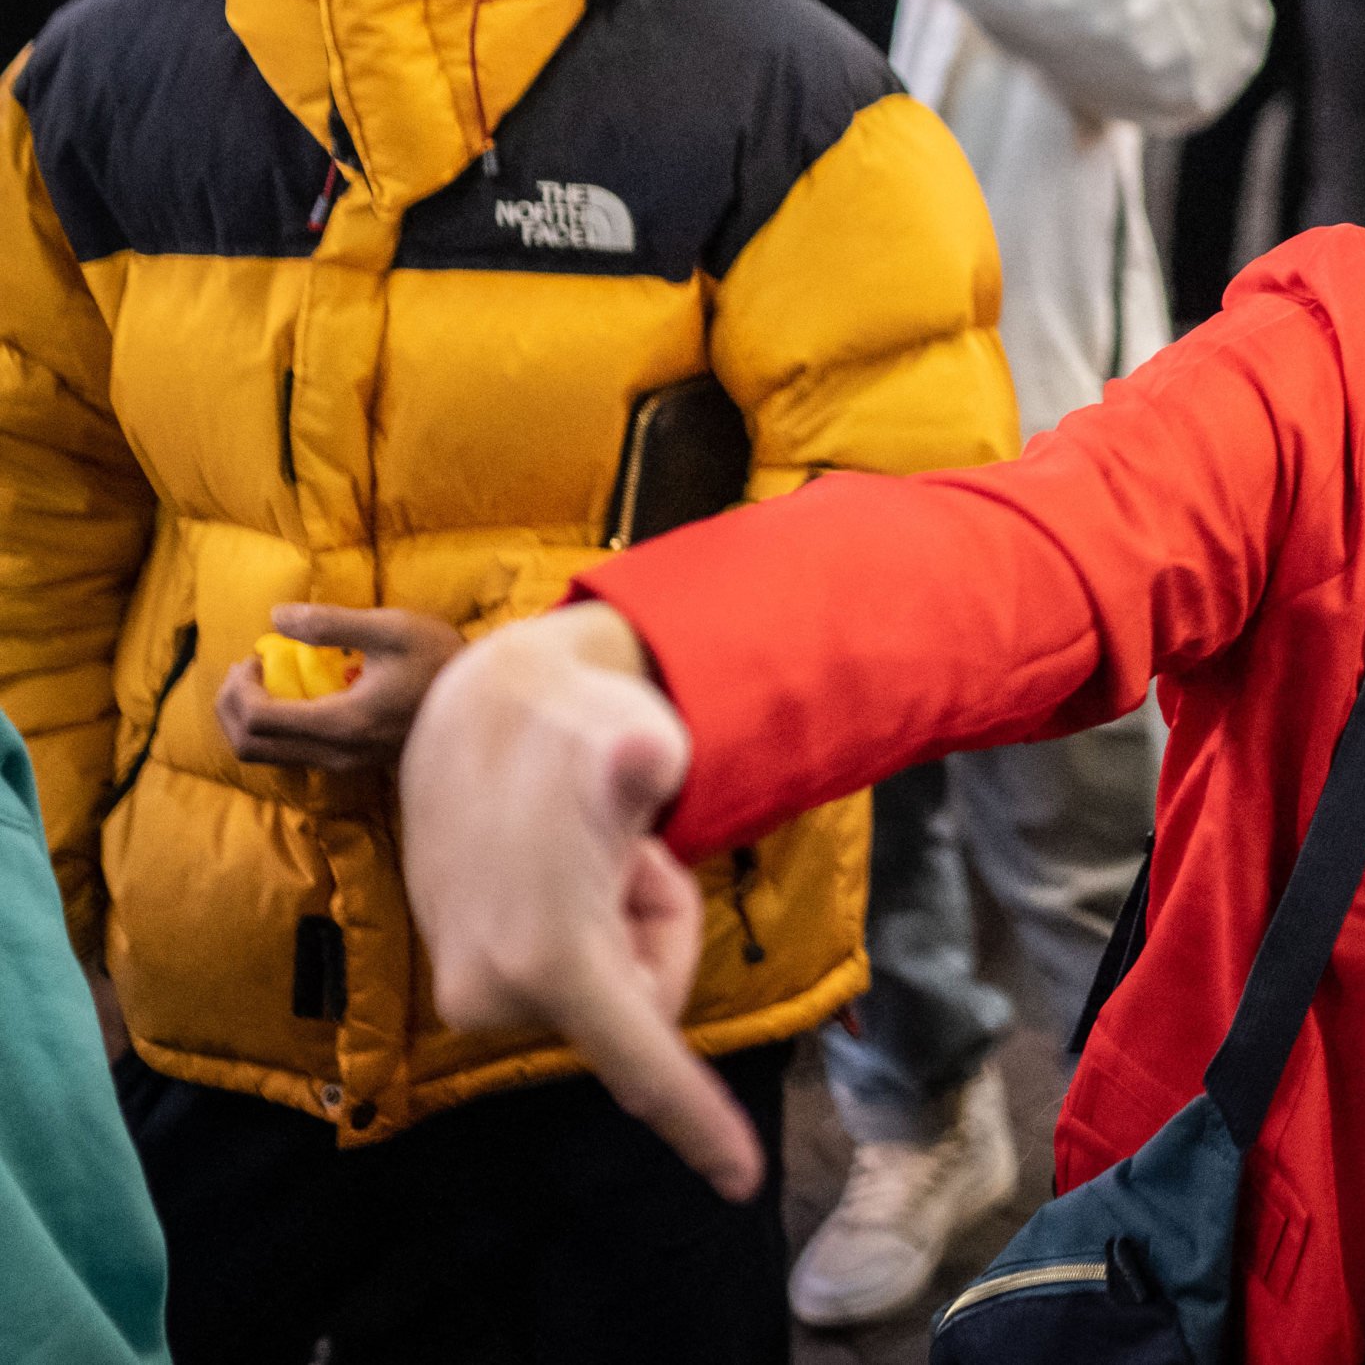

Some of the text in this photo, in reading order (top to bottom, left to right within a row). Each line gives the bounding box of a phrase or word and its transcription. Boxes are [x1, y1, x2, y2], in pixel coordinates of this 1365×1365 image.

[535, 180, 587, 204] THE
[495, 199, 586, 228] NORTH
[521, 223, 587, 250] FACE
